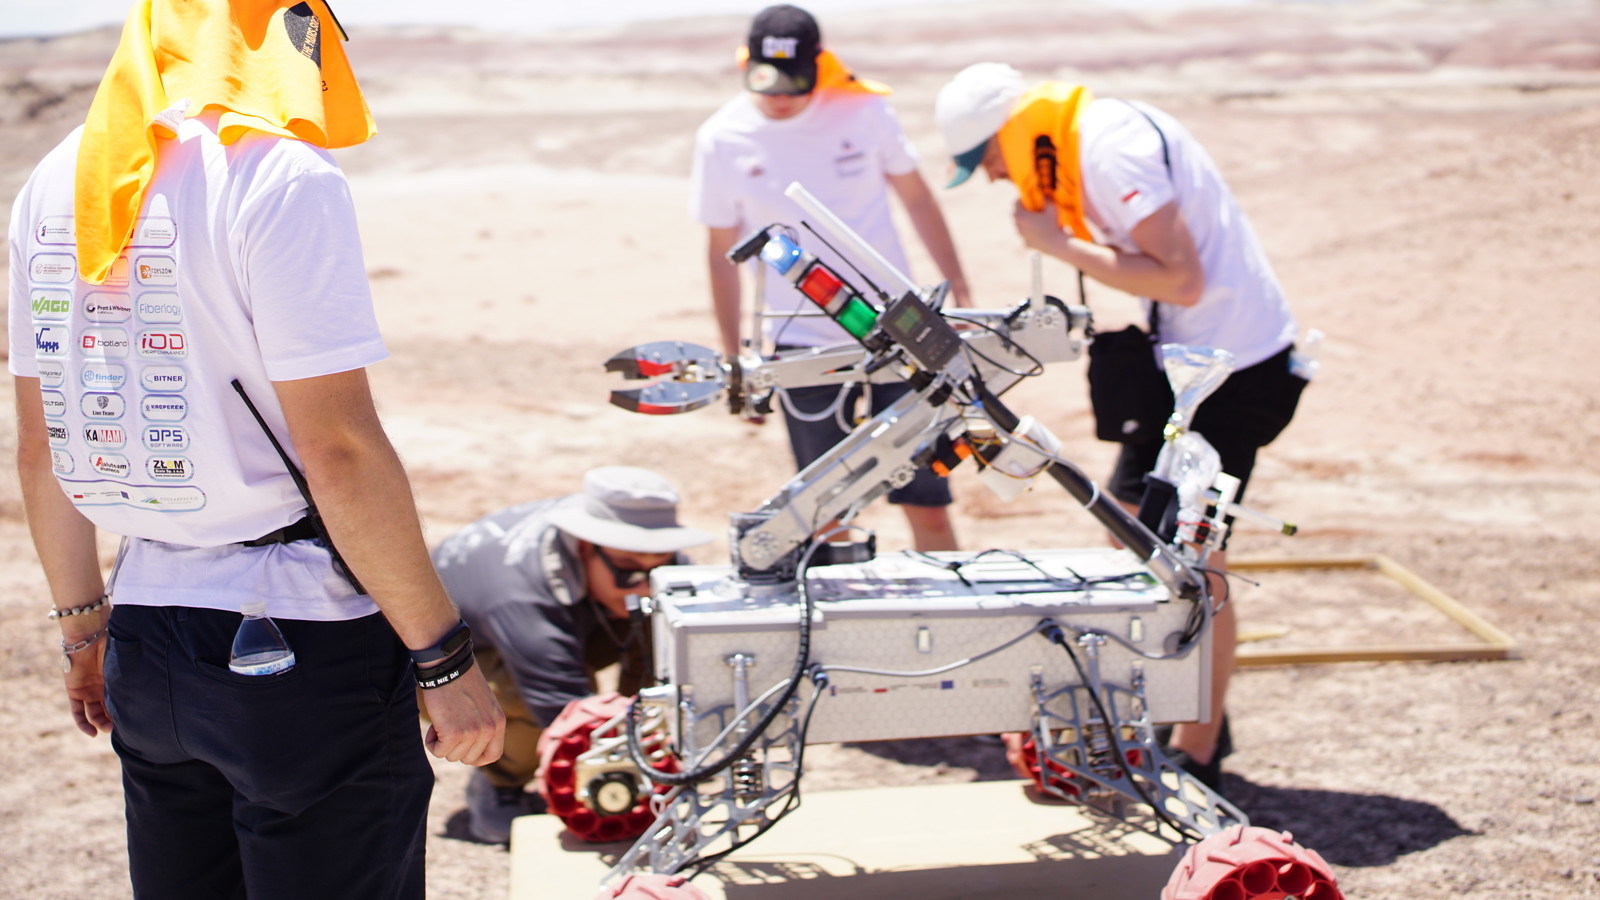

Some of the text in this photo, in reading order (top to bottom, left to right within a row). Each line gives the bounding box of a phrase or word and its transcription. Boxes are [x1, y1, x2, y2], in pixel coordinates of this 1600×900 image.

[31, 296, 70, 315] WAGO
[140, 304, 181, 315] Fiberlogy
[85, 429, 122, 443] KAMAMI
[149, 429, 183, 442] DPS
